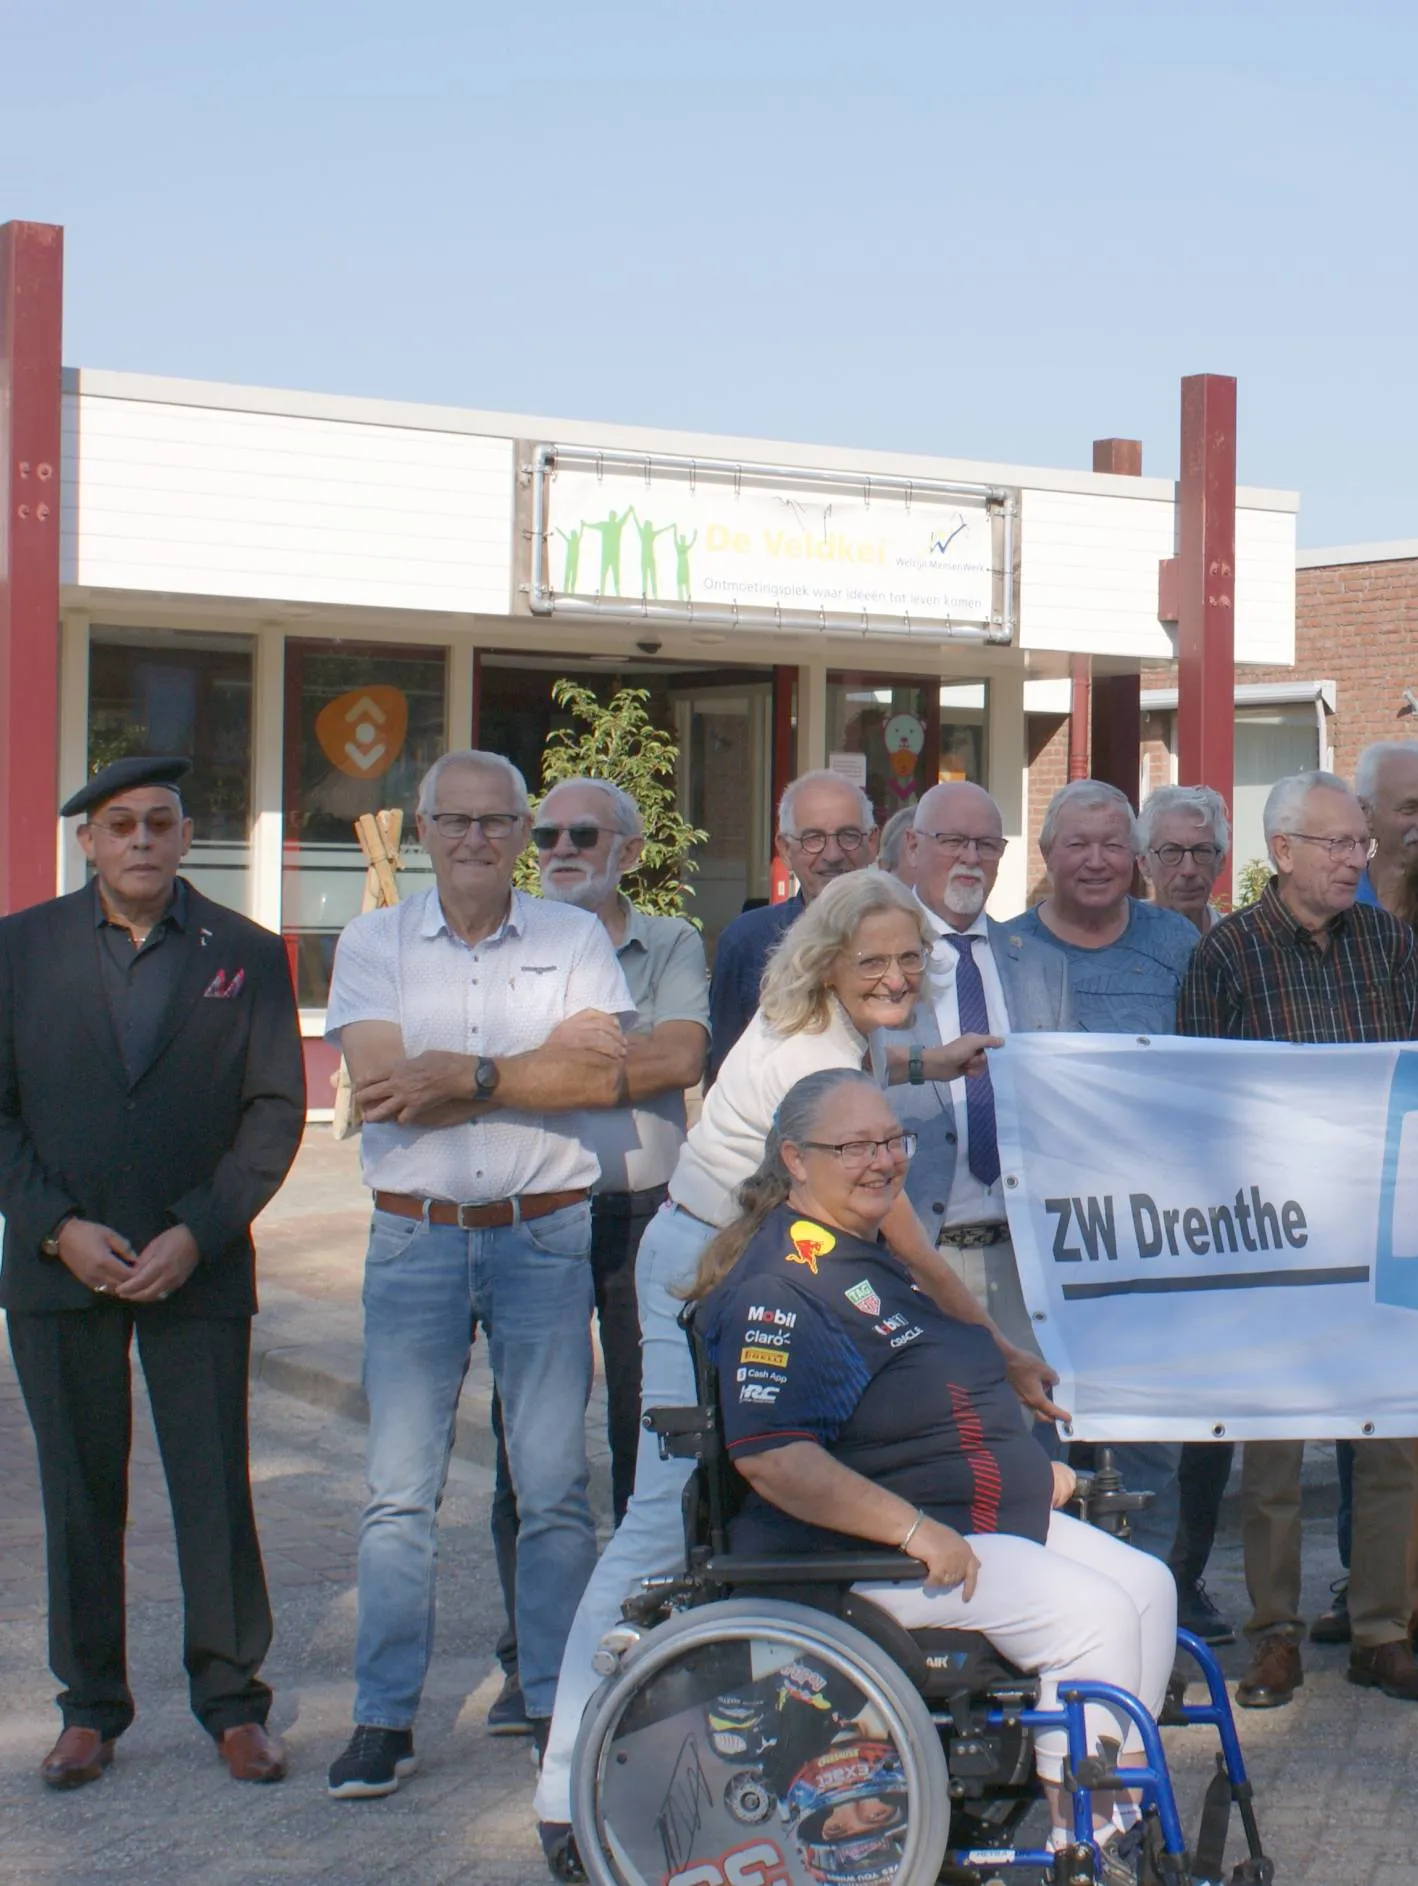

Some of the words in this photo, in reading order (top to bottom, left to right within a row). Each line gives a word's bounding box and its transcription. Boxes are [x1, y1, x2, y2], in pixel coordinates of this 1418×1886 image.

[705, 521, 751, 555] De
[762, 526, 887, 565] Veldkei
[703, 577, 808, 598] Ontmoetingsplek
[812, 587, 843, 599] waar
[889, 592, 906, 604] tot
[909, 593, 940, 606] leven
[943, 596, 982, 609] komen
[1045, 1195, 1118, 1263] ZW
[1129, 1185, 1309, 1260] Drenthe
[849, 1283, 872, 1302] TAG
[747, 1305, 797, 1329] Mobil
[744, 1329, 788, 1347] Claro
[890, 1326, 924, 1348] ORACLE
[747, 1368, 769, 1379] Cash
[770, 1371, 788, 1384] App
